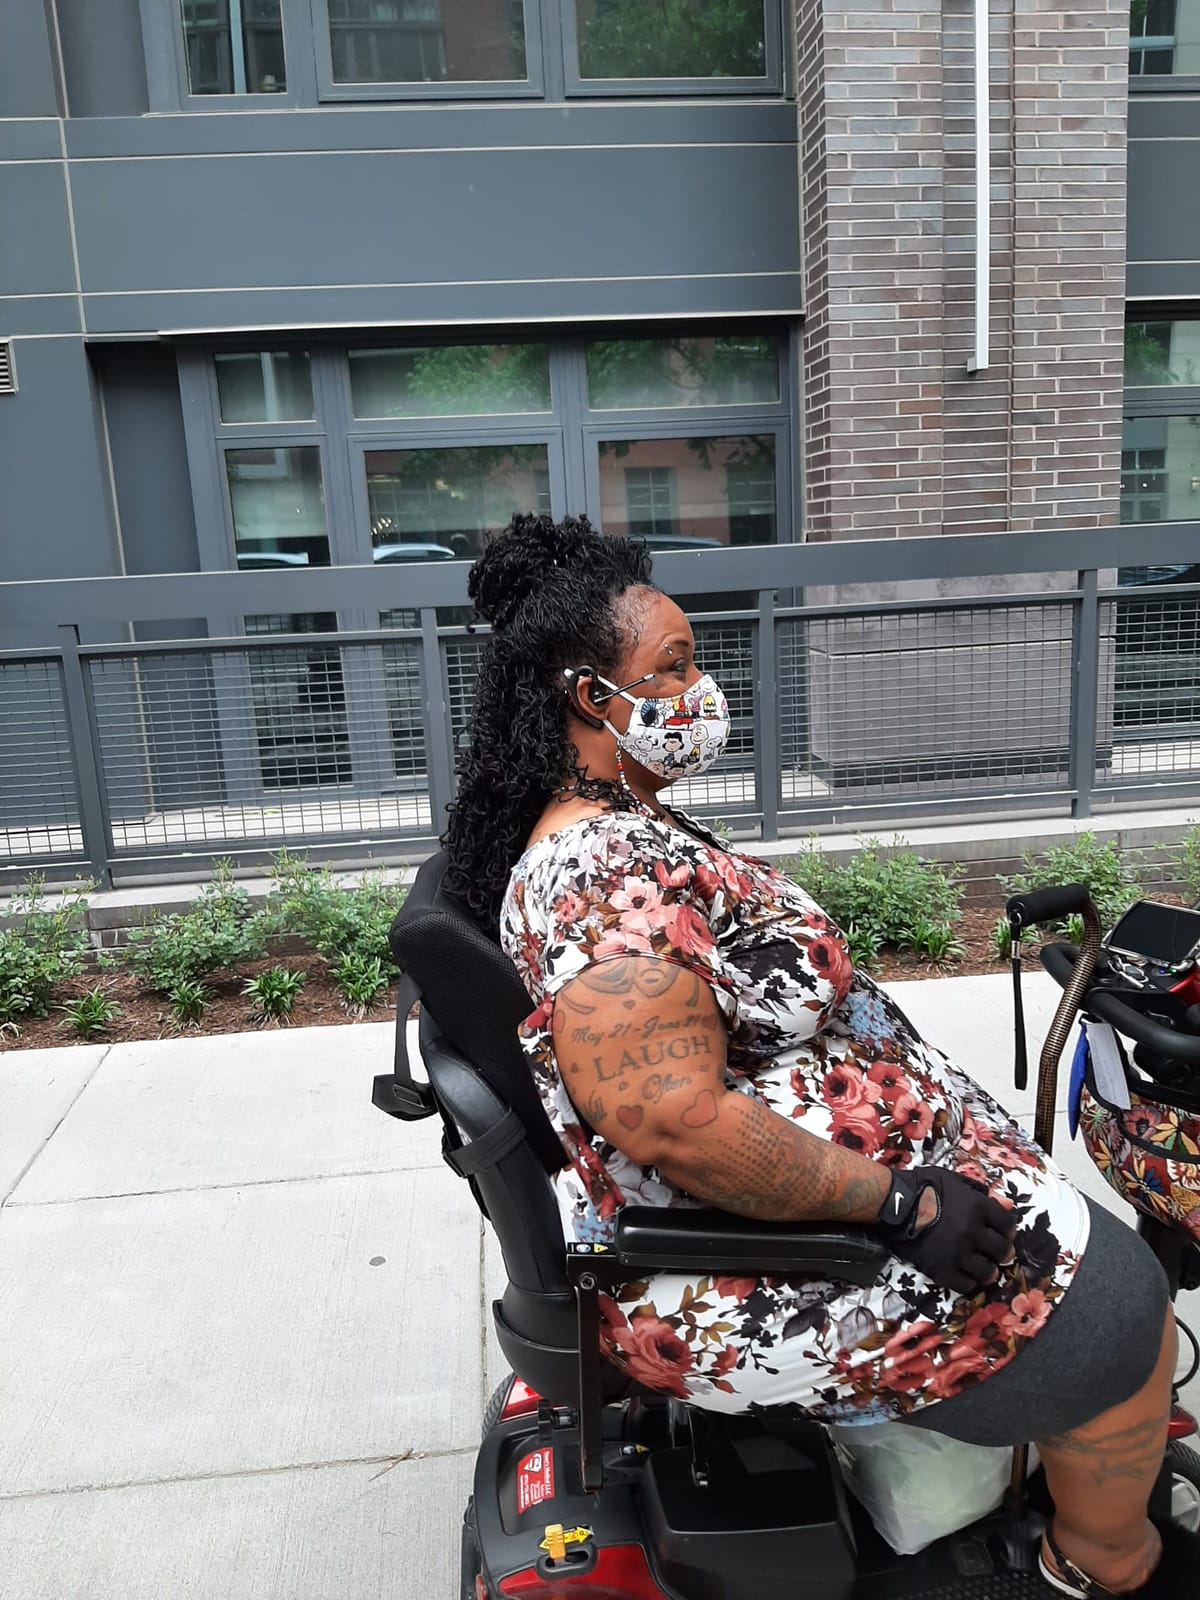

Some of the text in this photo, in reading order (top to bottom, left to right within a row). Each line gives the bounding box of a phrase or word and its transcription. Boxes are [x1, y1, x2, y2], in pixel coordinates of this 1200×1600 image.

[572, 1027, 602, 1046] May
[609, 1023, 630, 1038] 21
[641, 1016, 680, 1038] June
[593, 1035, 712, 1082] LAUGH
[641, 1073, 692, 1104] Often
